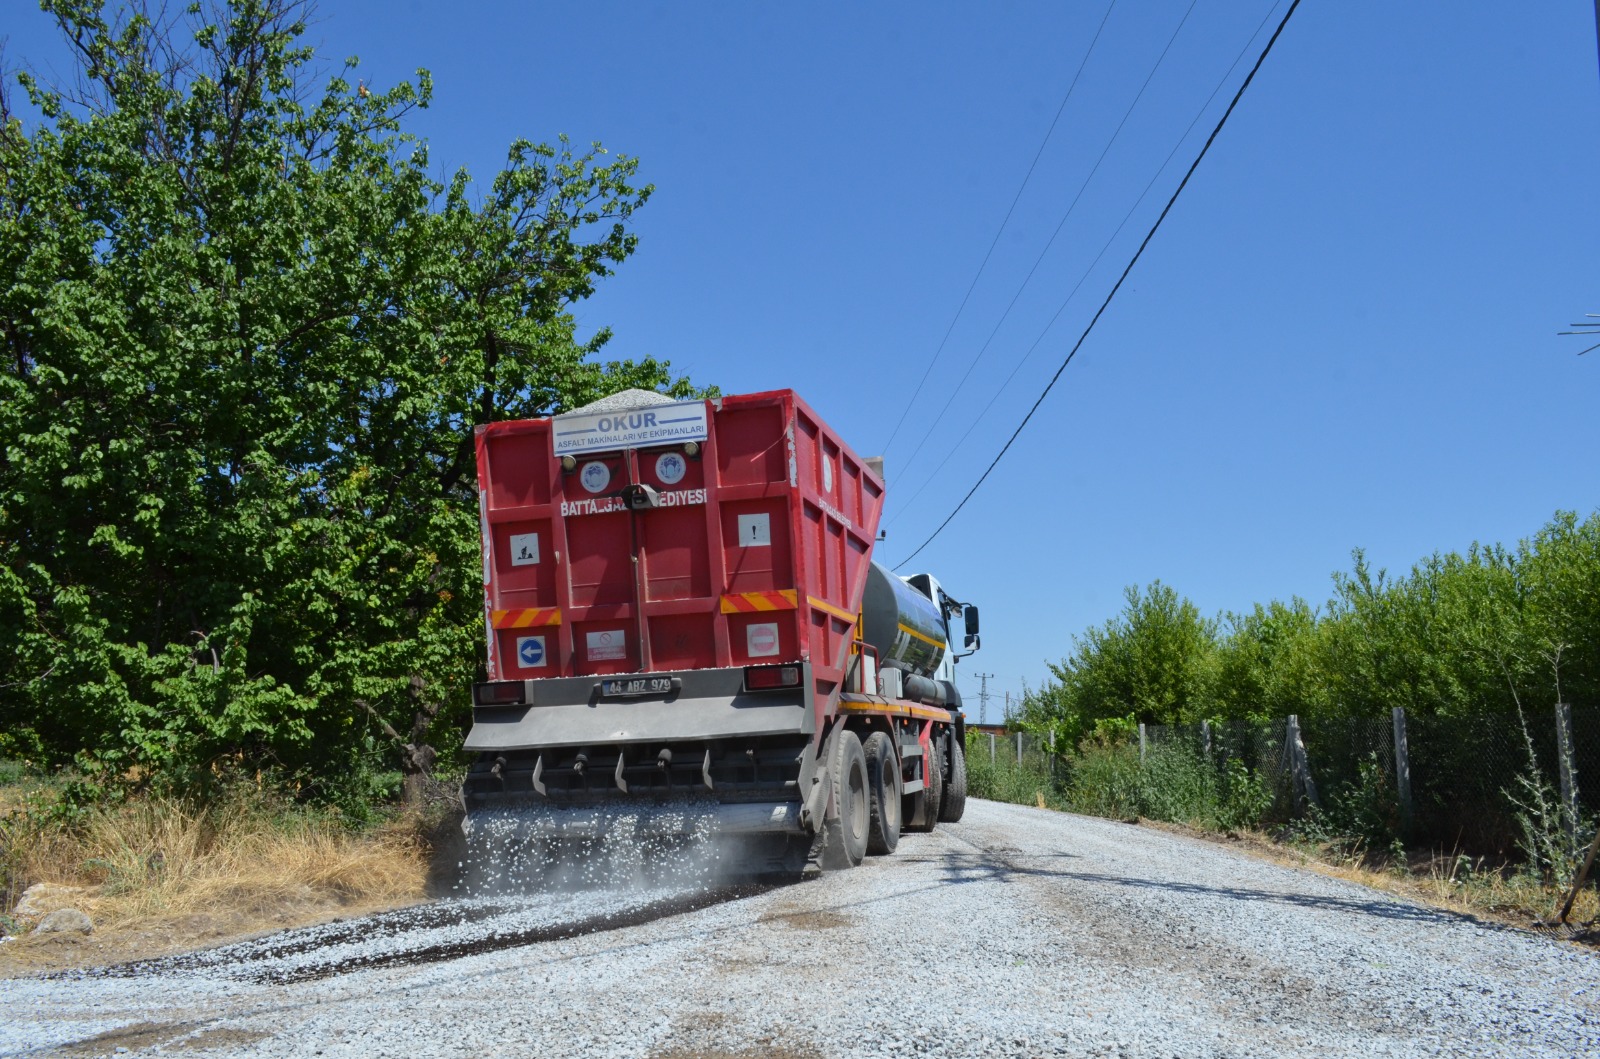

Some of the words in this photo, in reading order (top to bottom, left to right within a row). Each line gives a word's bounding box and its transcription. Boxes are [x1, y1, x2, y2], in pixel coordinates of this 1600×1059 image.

[598, 412, 657, 433] OKUR
[558, 438, 586, 449] ASFALT
[587, 434, 636, 445] MAKİNALARI
[637, 431, 648, 440] VE
[650, 425, 704, 438] EKİPMANLARI
[610, 681, 622, 694] 44
[627, 679, 646, 693] ABZ
[651, 678, 671, 691] 979
